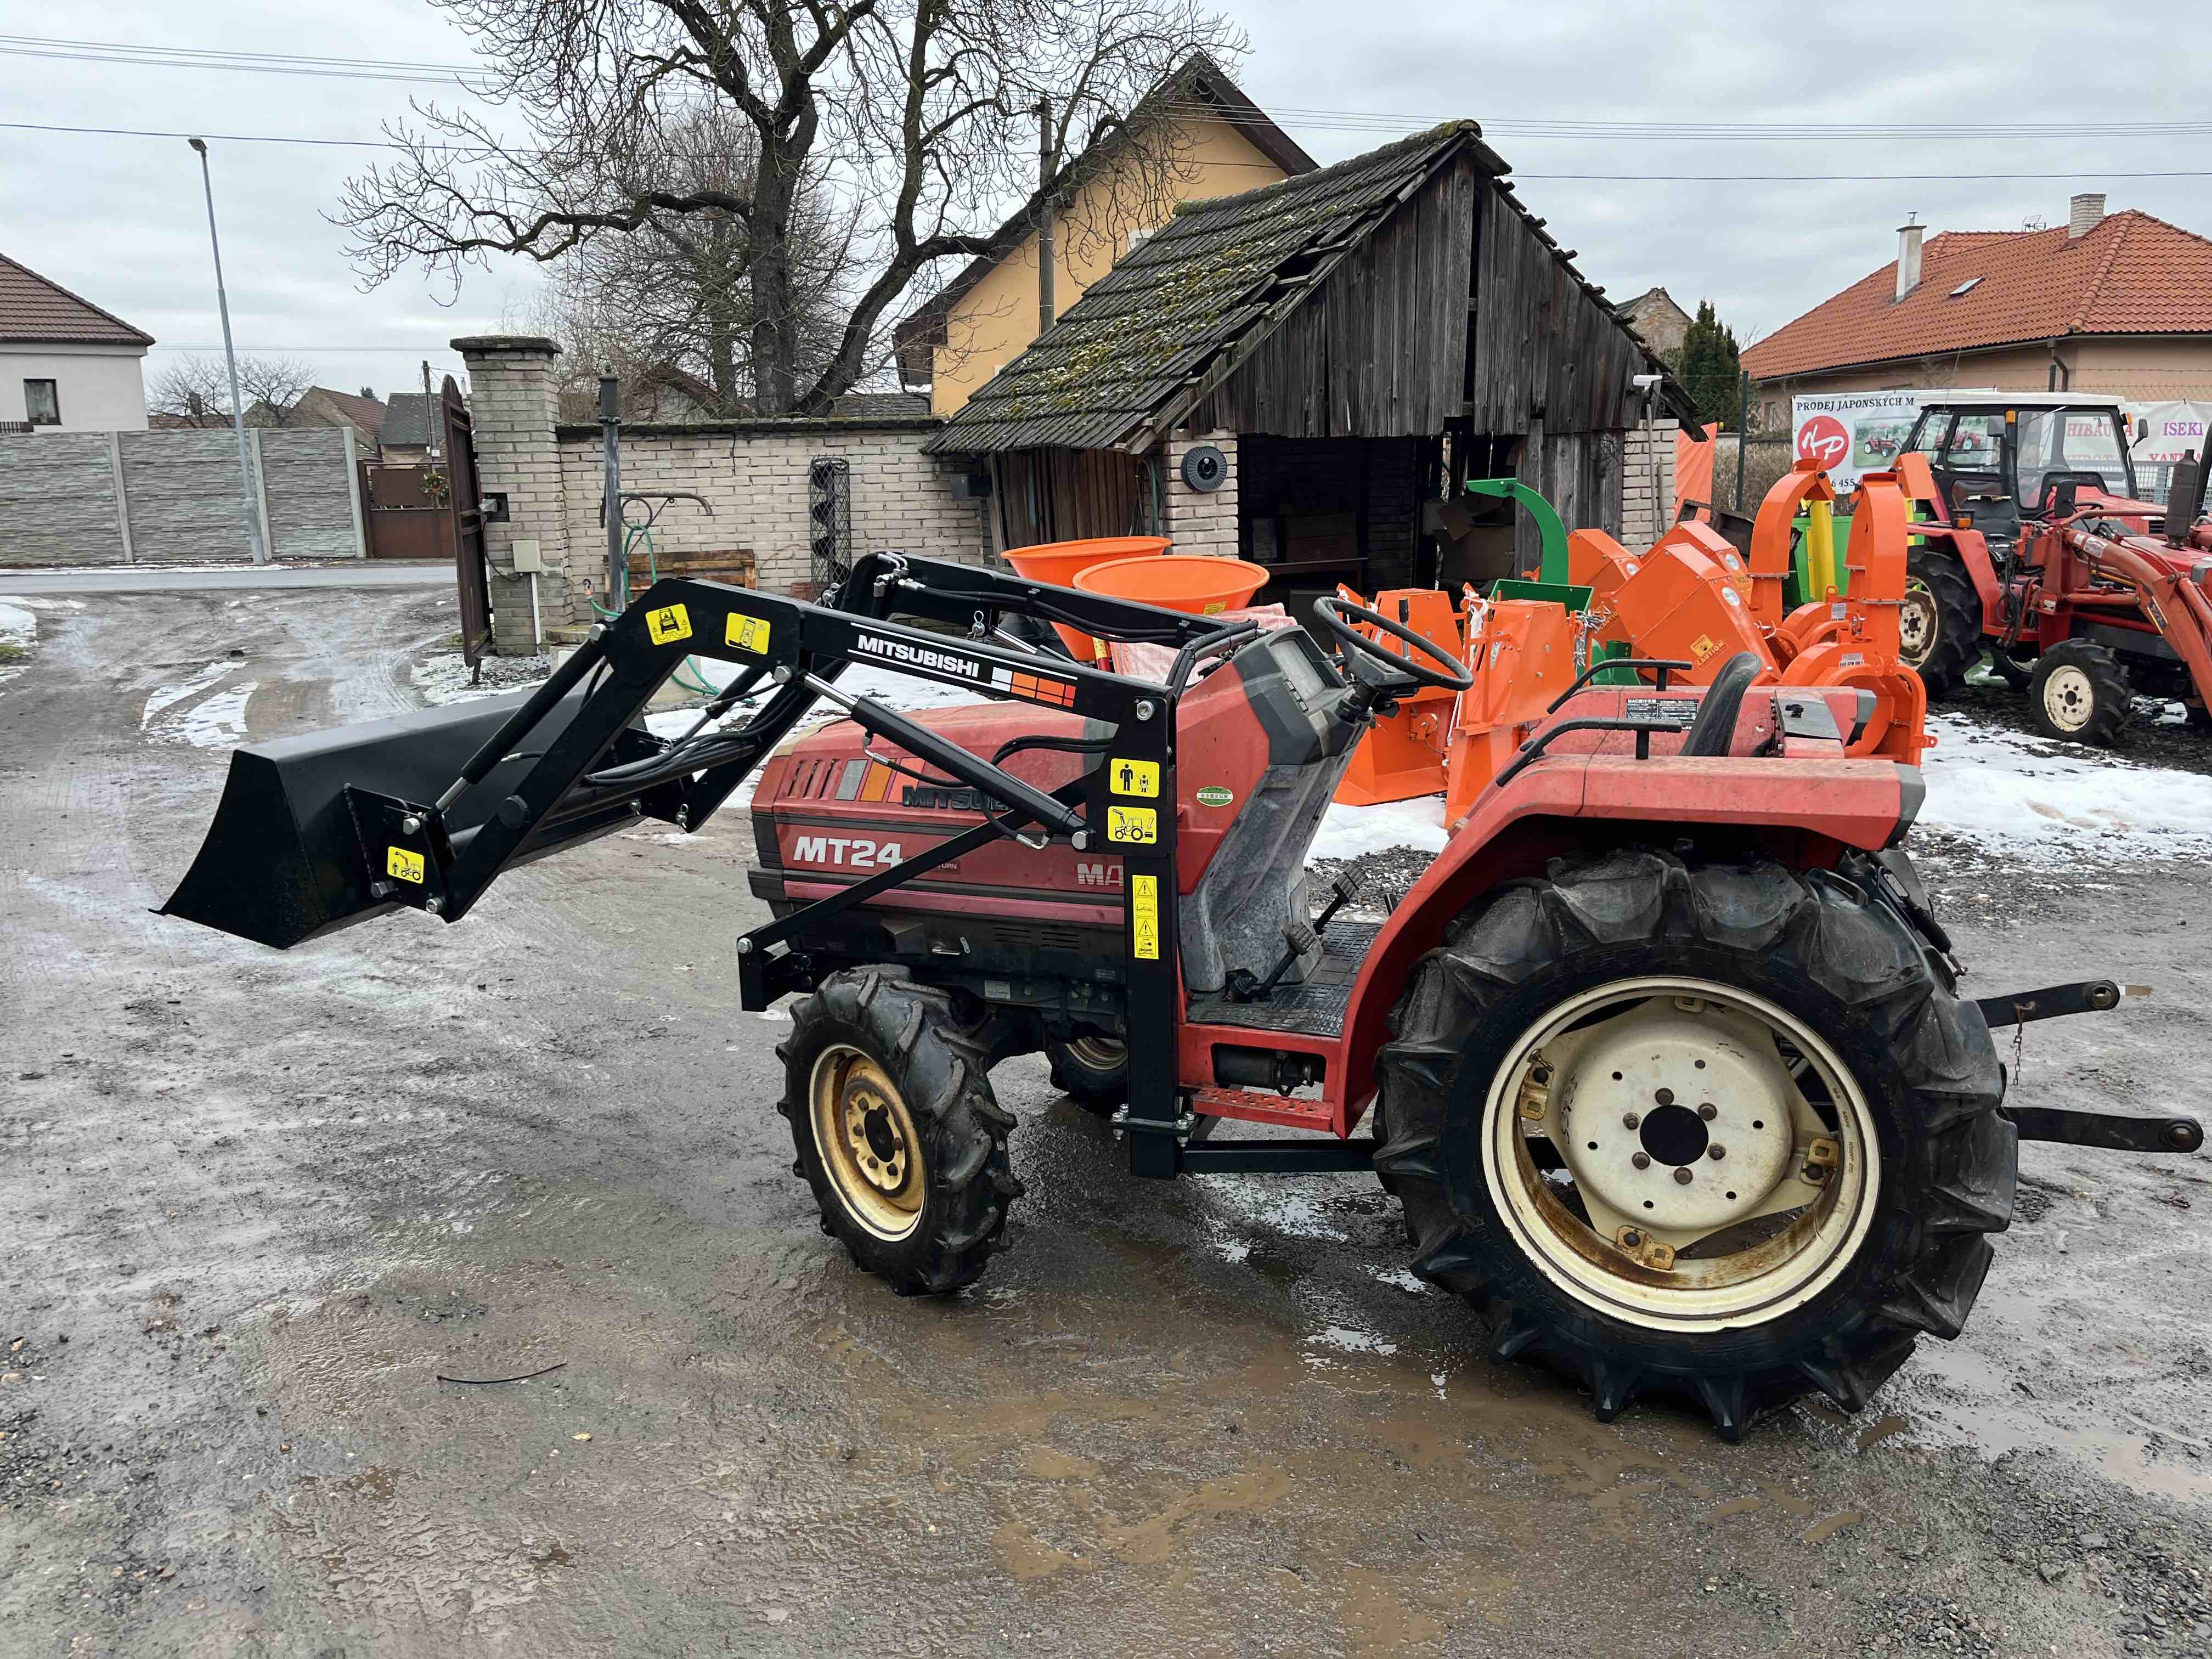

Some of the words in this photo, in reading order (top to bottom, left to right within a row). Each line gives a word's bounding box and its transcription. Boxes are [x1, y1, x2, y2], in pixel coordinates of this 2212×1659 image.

[1797, 401, 1835, 411] PRODEJ
[1905, 397, 1915, 405] M
[2067, 422, 2133, 437] HIBAUA
[2163, 422, 2204, 436] ISEKI
[1831, 478, 1836, 487] 6
[1838, 478, 1855, 487] 455
[857, 634, 979, 678] MITSUBISHI
[1697, 640, 1726, 666] CAUTION
[903, 786, 1009, 810] MITSU
[793, 836, 904, 867] MT24
[938, 862, 957, 870] URN
[1077, 864, 1124, 886] MA
